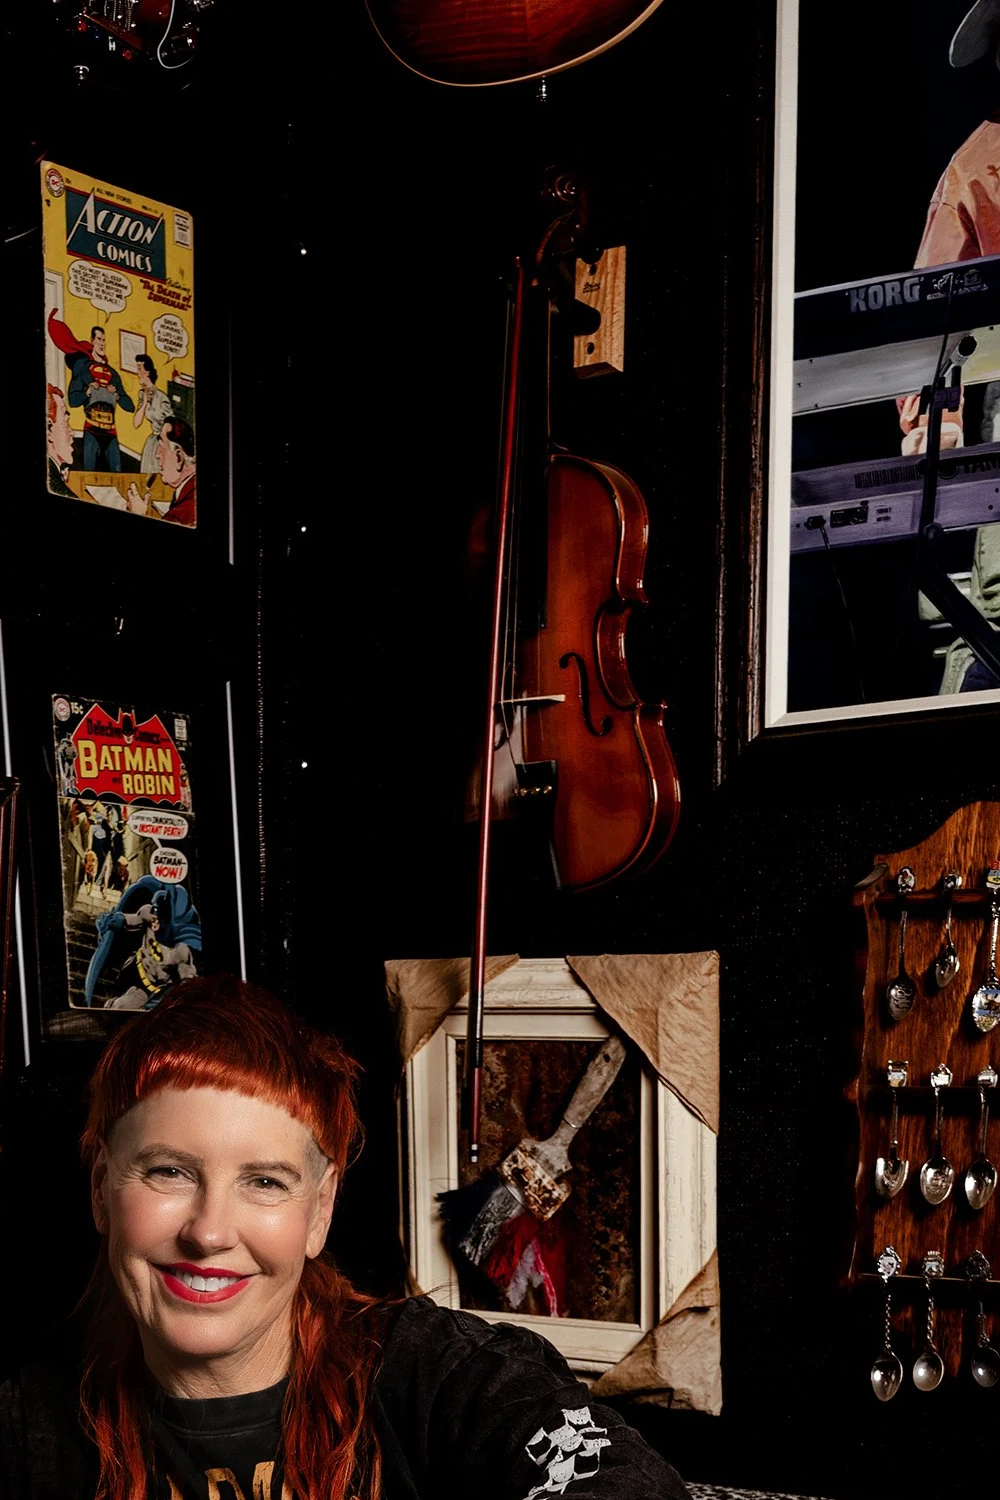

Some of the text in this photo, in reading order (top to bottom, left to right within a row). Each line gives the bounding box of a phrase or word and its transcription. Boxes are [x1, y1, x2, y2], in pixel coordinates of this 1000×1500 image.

[67, 187, 163, 246] ACTION
[97, 241, 153, 273] COMICS
[849, 277, 921, 313] KORG
[77, 740, 173, 778] BATMAN
[121, 774, 175, 795] ROBIN
